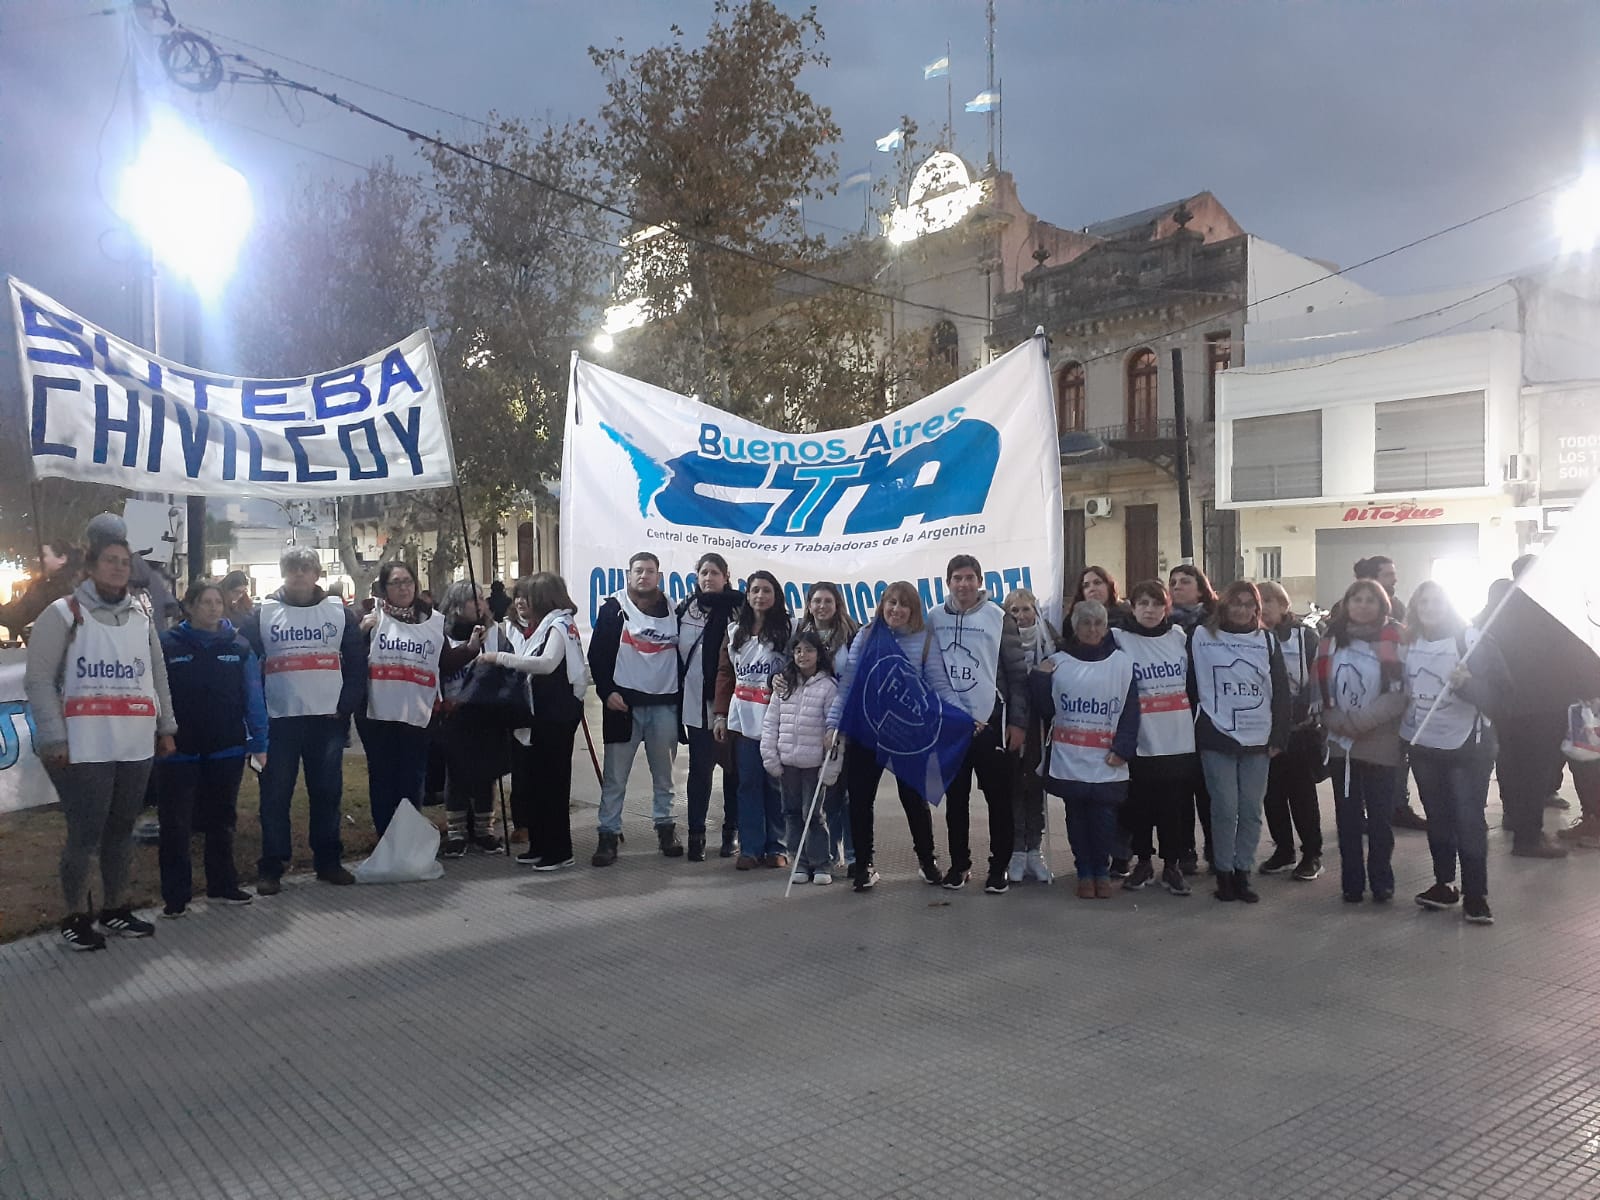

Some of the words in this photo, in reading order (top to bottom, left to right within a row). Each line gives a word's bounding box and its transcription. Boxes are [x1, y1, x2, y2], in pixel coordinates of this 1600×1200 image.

[32, 375, 424, 482] CHIVILCOY
[699, 423, 847, 462] Buenos
[860, 406, 966, 456] Aires
[1558, 435, 1600, 449] TODO
[1559, 451, 1586, 464] LOS
[655, 418, 1001, 536] CTA
[646, 528, 683, 542] Central
[686, 533, 699, 543] de
[702, 534, 778, 552] Trabajadores
[780, 543, 790, 553] y
[794, 540, 879, 553] Trabajadoras
[882, 536, 899, 546] de
[902, 532, 914, 543] la
[918, 522, 986, 541] Argentina
[269, 624, 322, 642] Suteba
[379, 633, 423, 654] Suteba
[76, 656, 134, 679] Suteba
[1132, 660, 1181, 681] Suteba
[1223, 682, 1263, 697] F.E.B.
[1060, 693, 1108, 716] Suteba
